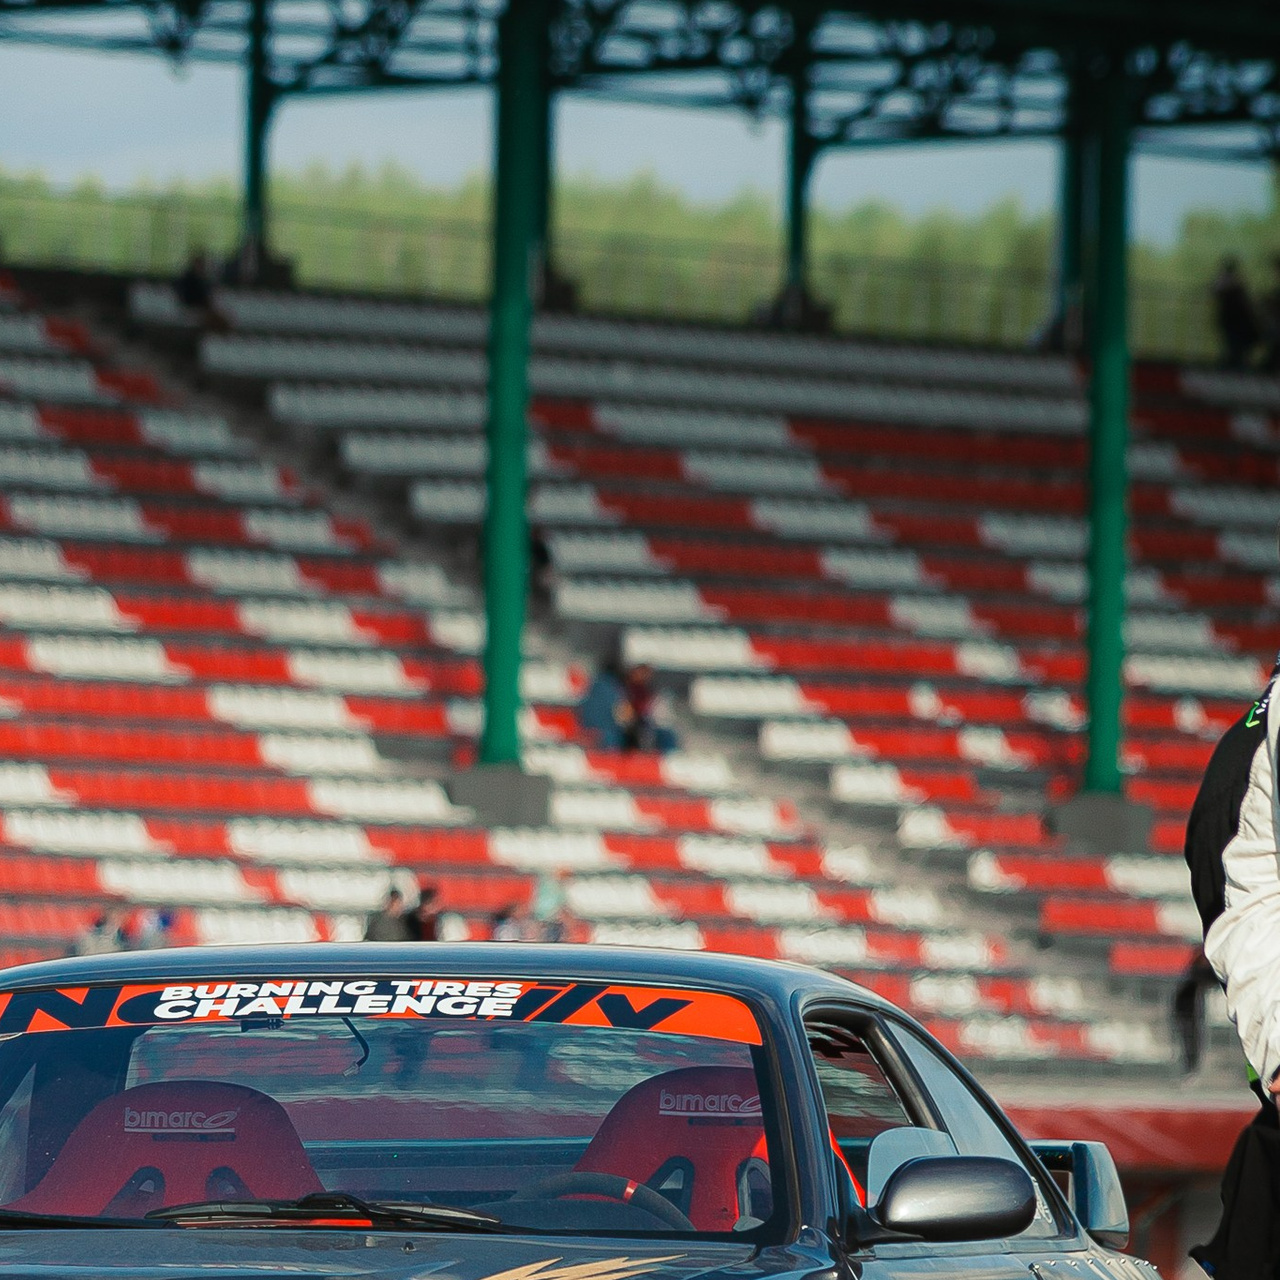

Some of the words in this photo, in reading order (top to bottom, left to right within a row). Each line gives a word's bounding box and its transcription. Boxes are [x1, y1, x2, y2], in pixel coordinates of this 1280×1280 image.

[160, 981, 387, 1001] BURNING
[389, 981, 522, 999] TIRES
[153, 995, 517, 1019] CHALLENGE
[659, 1089, 762, 1113] bimarco
[124, 1107, 239, 1129] bimarco
